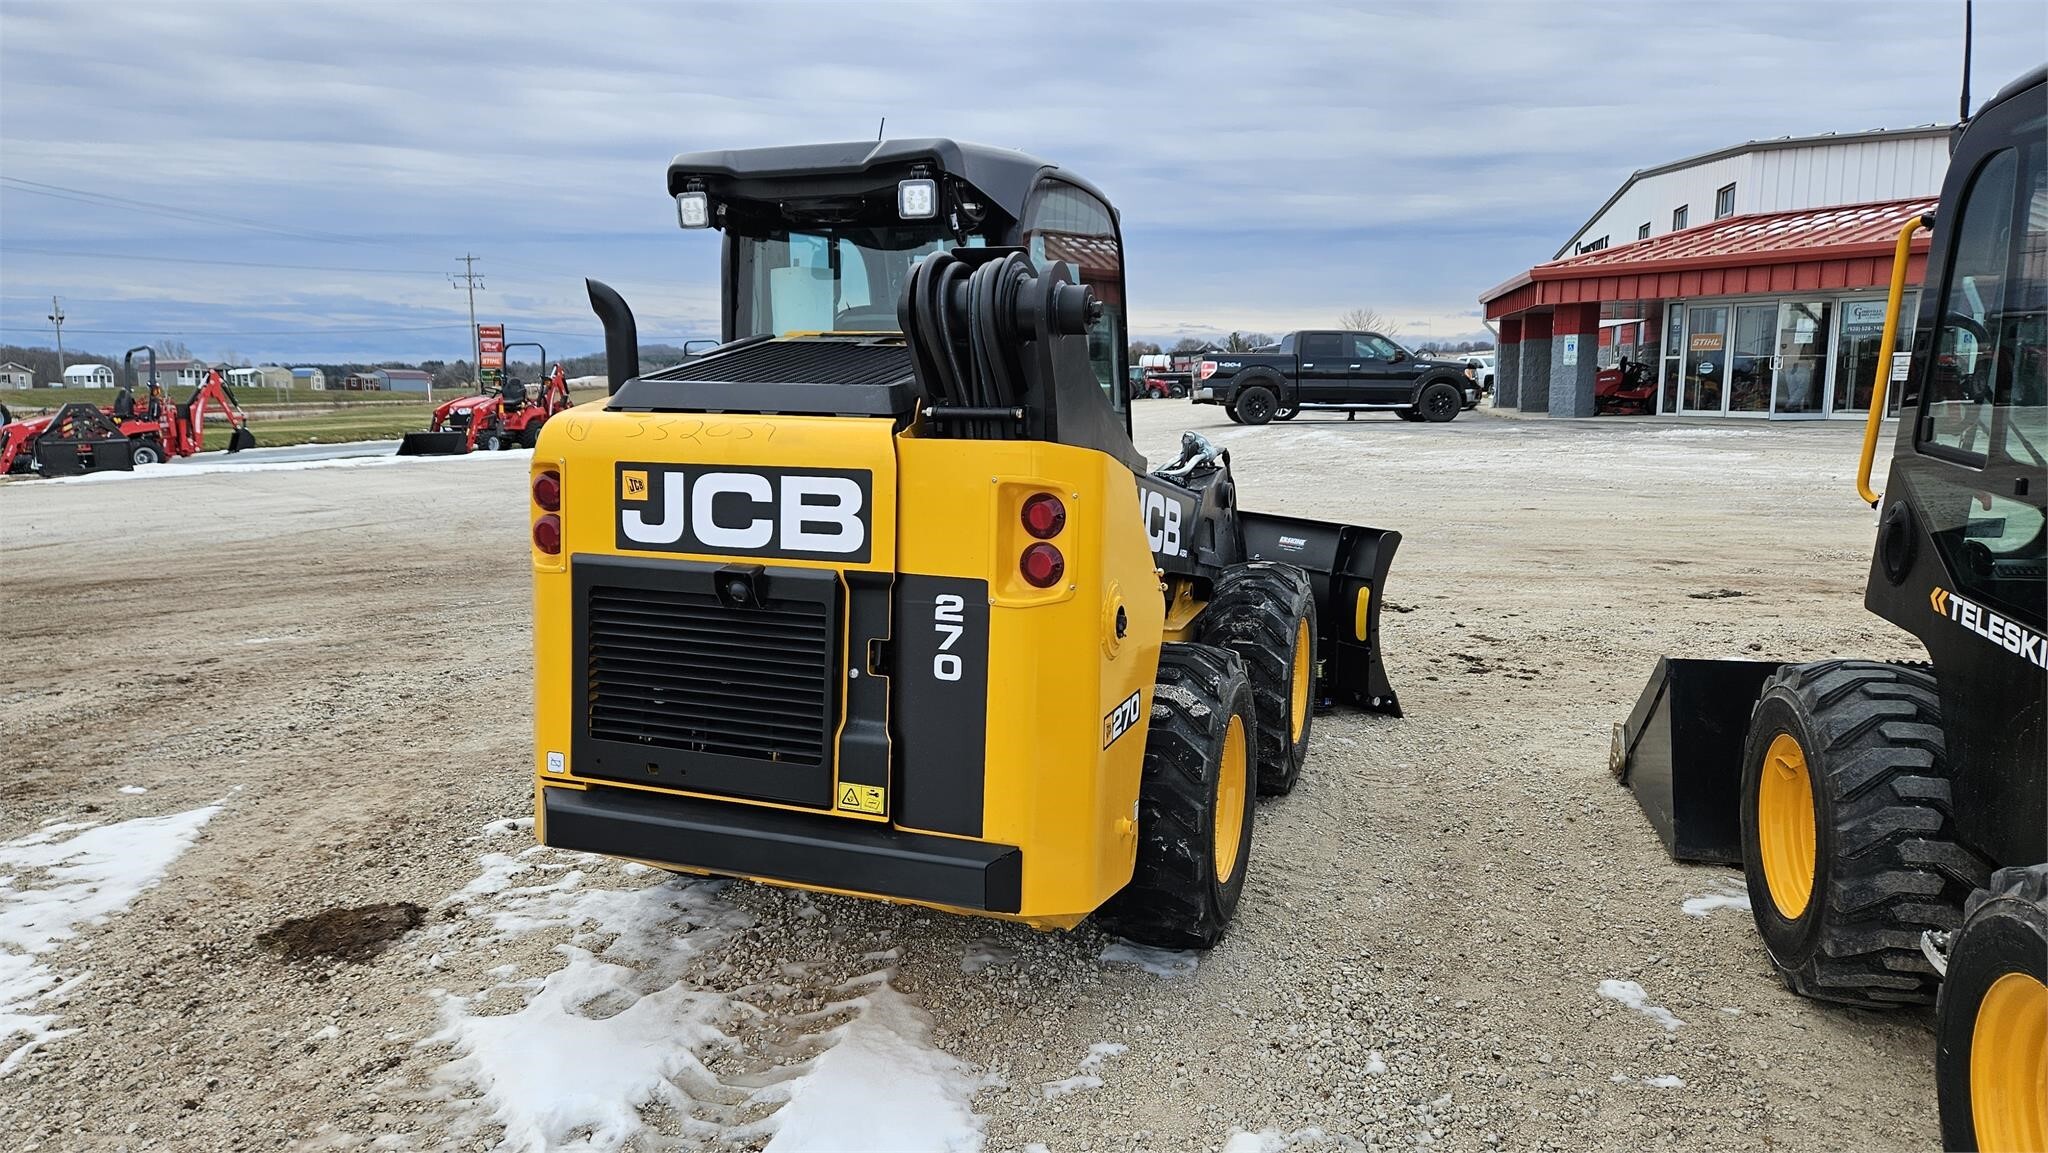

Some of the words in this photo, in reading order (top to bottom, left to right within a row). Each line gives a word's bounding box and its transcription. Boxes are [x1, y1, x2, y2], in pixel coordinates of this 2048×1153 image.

[1692, 338, 1721, 347] STIHL
[622, 471, 865, 553] JCB
[629, 478, 644, 493] JCB
[933, 594, 964, 681] 270
[1949, 593, 2048, 670] TELESKI
[1112, 692, 1140, 740] 270
